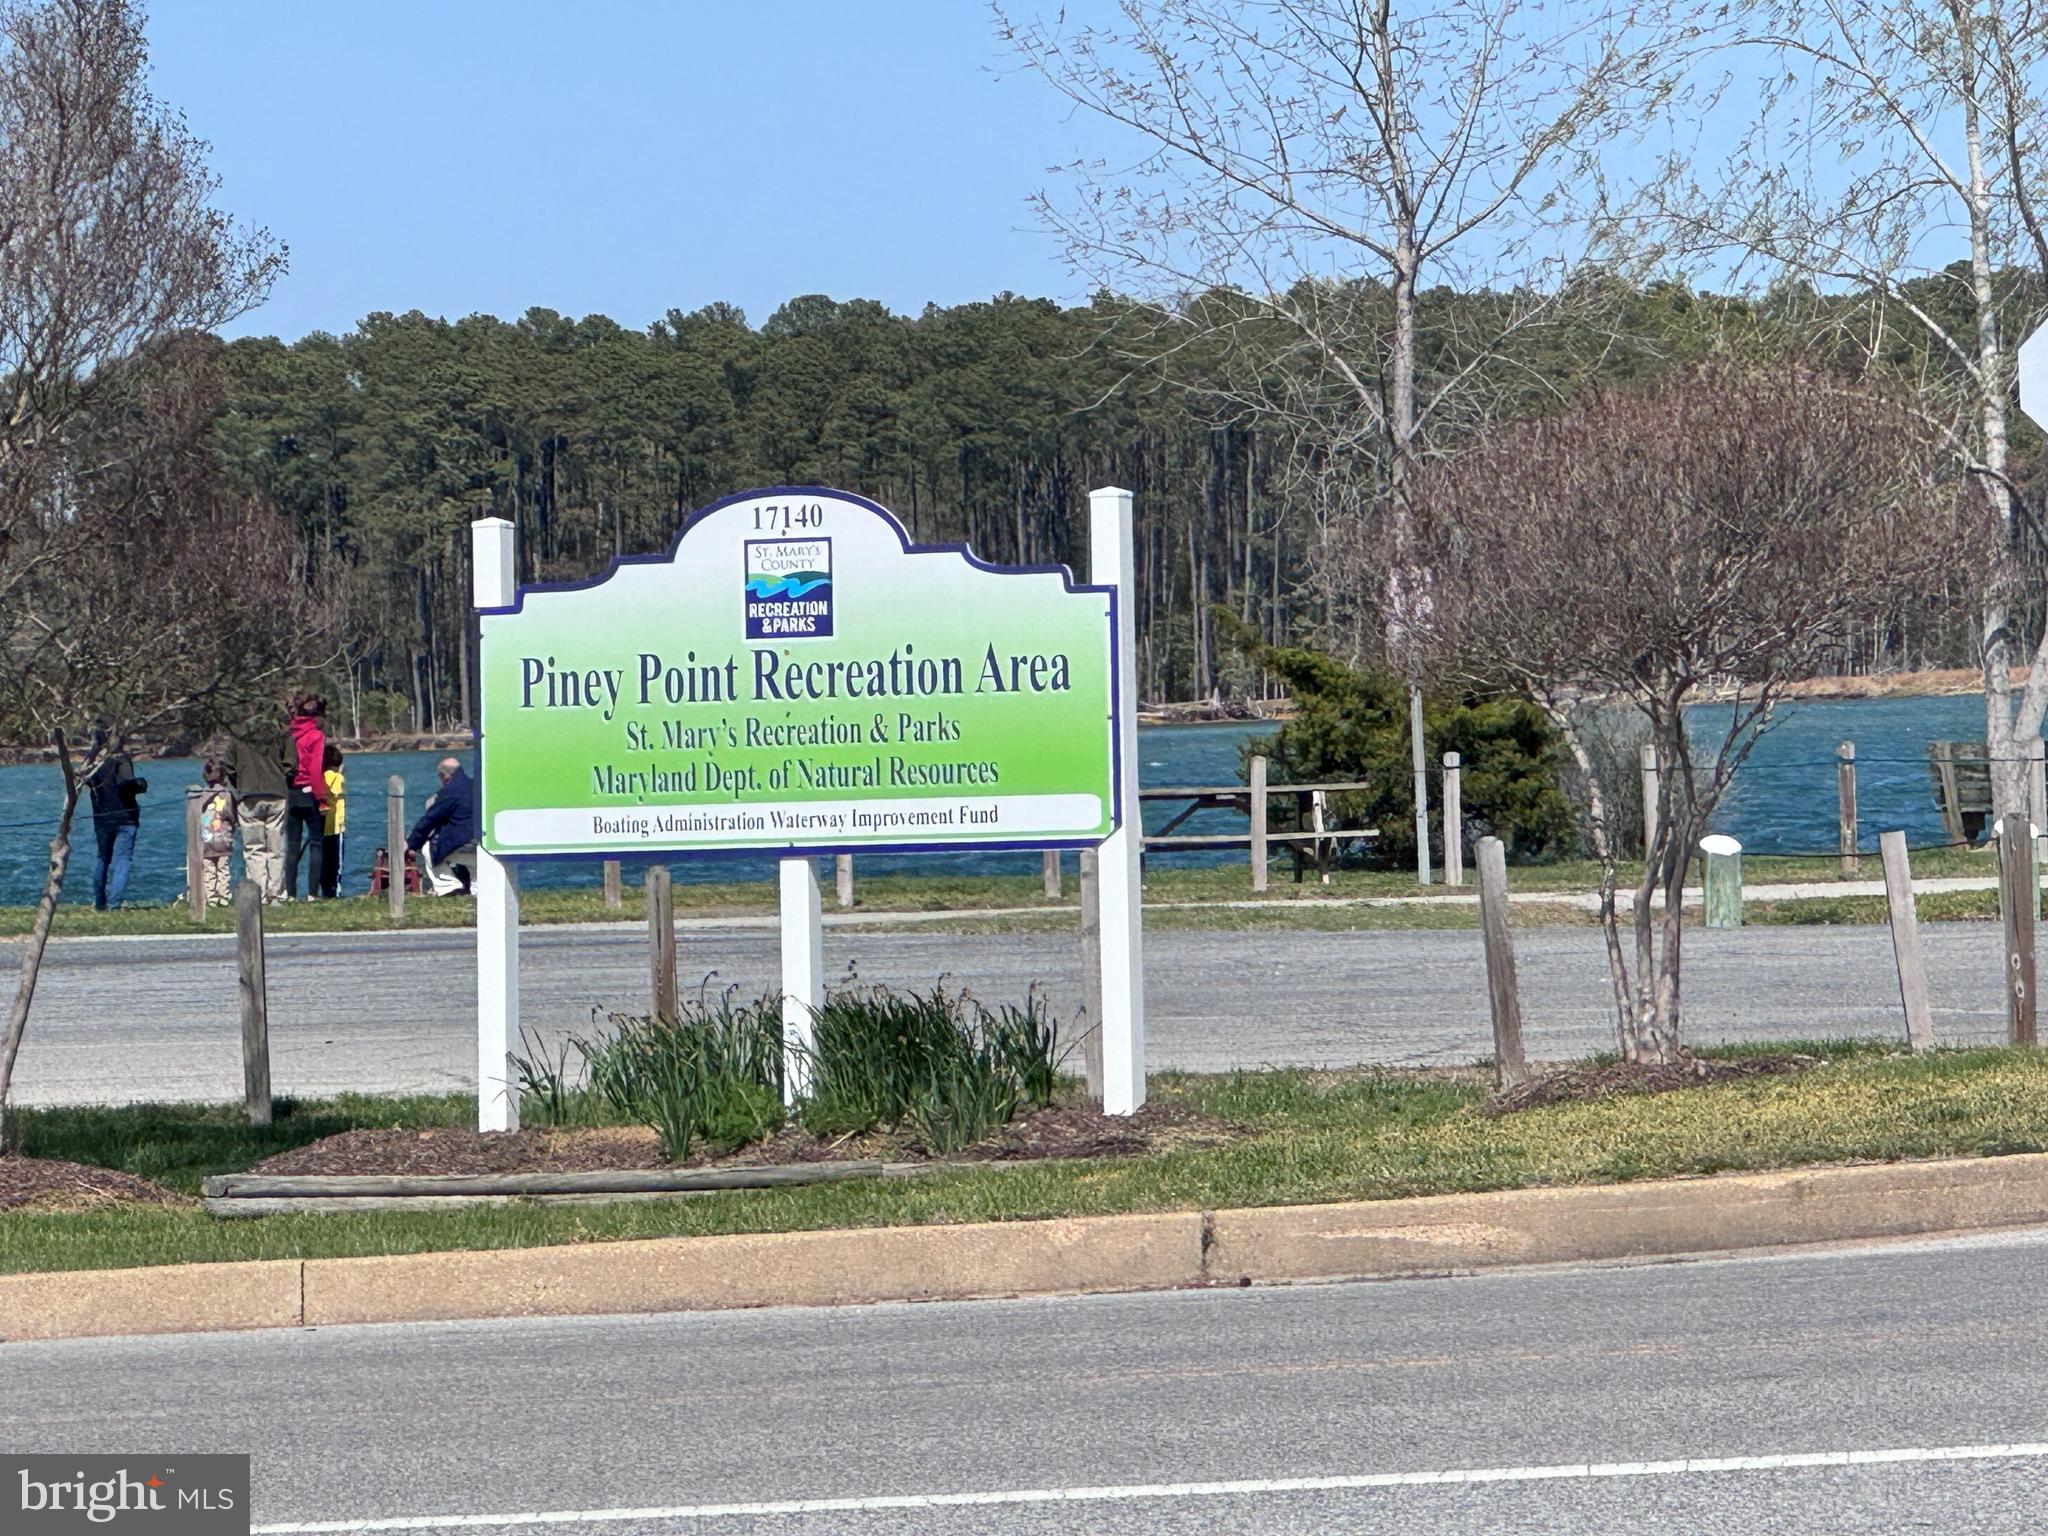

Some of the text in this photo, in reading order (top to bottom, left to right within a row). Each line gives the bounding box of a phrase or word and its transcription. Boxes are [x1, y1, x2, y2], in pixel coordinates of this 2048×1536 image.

[754, 504, 823, 530] 17140
[749, 601, 828, 618] RECREATION
[520, 641, 1071, 721] Piney Point Recreation Area
[626, 712, 961, 757] St. Mary's Recreation & Parks
[593, 756, 999, 802] Maryland Dept. of Natural Resources
[593, 805, 998, 838] Boating Administration Waterway Improvement Fund
